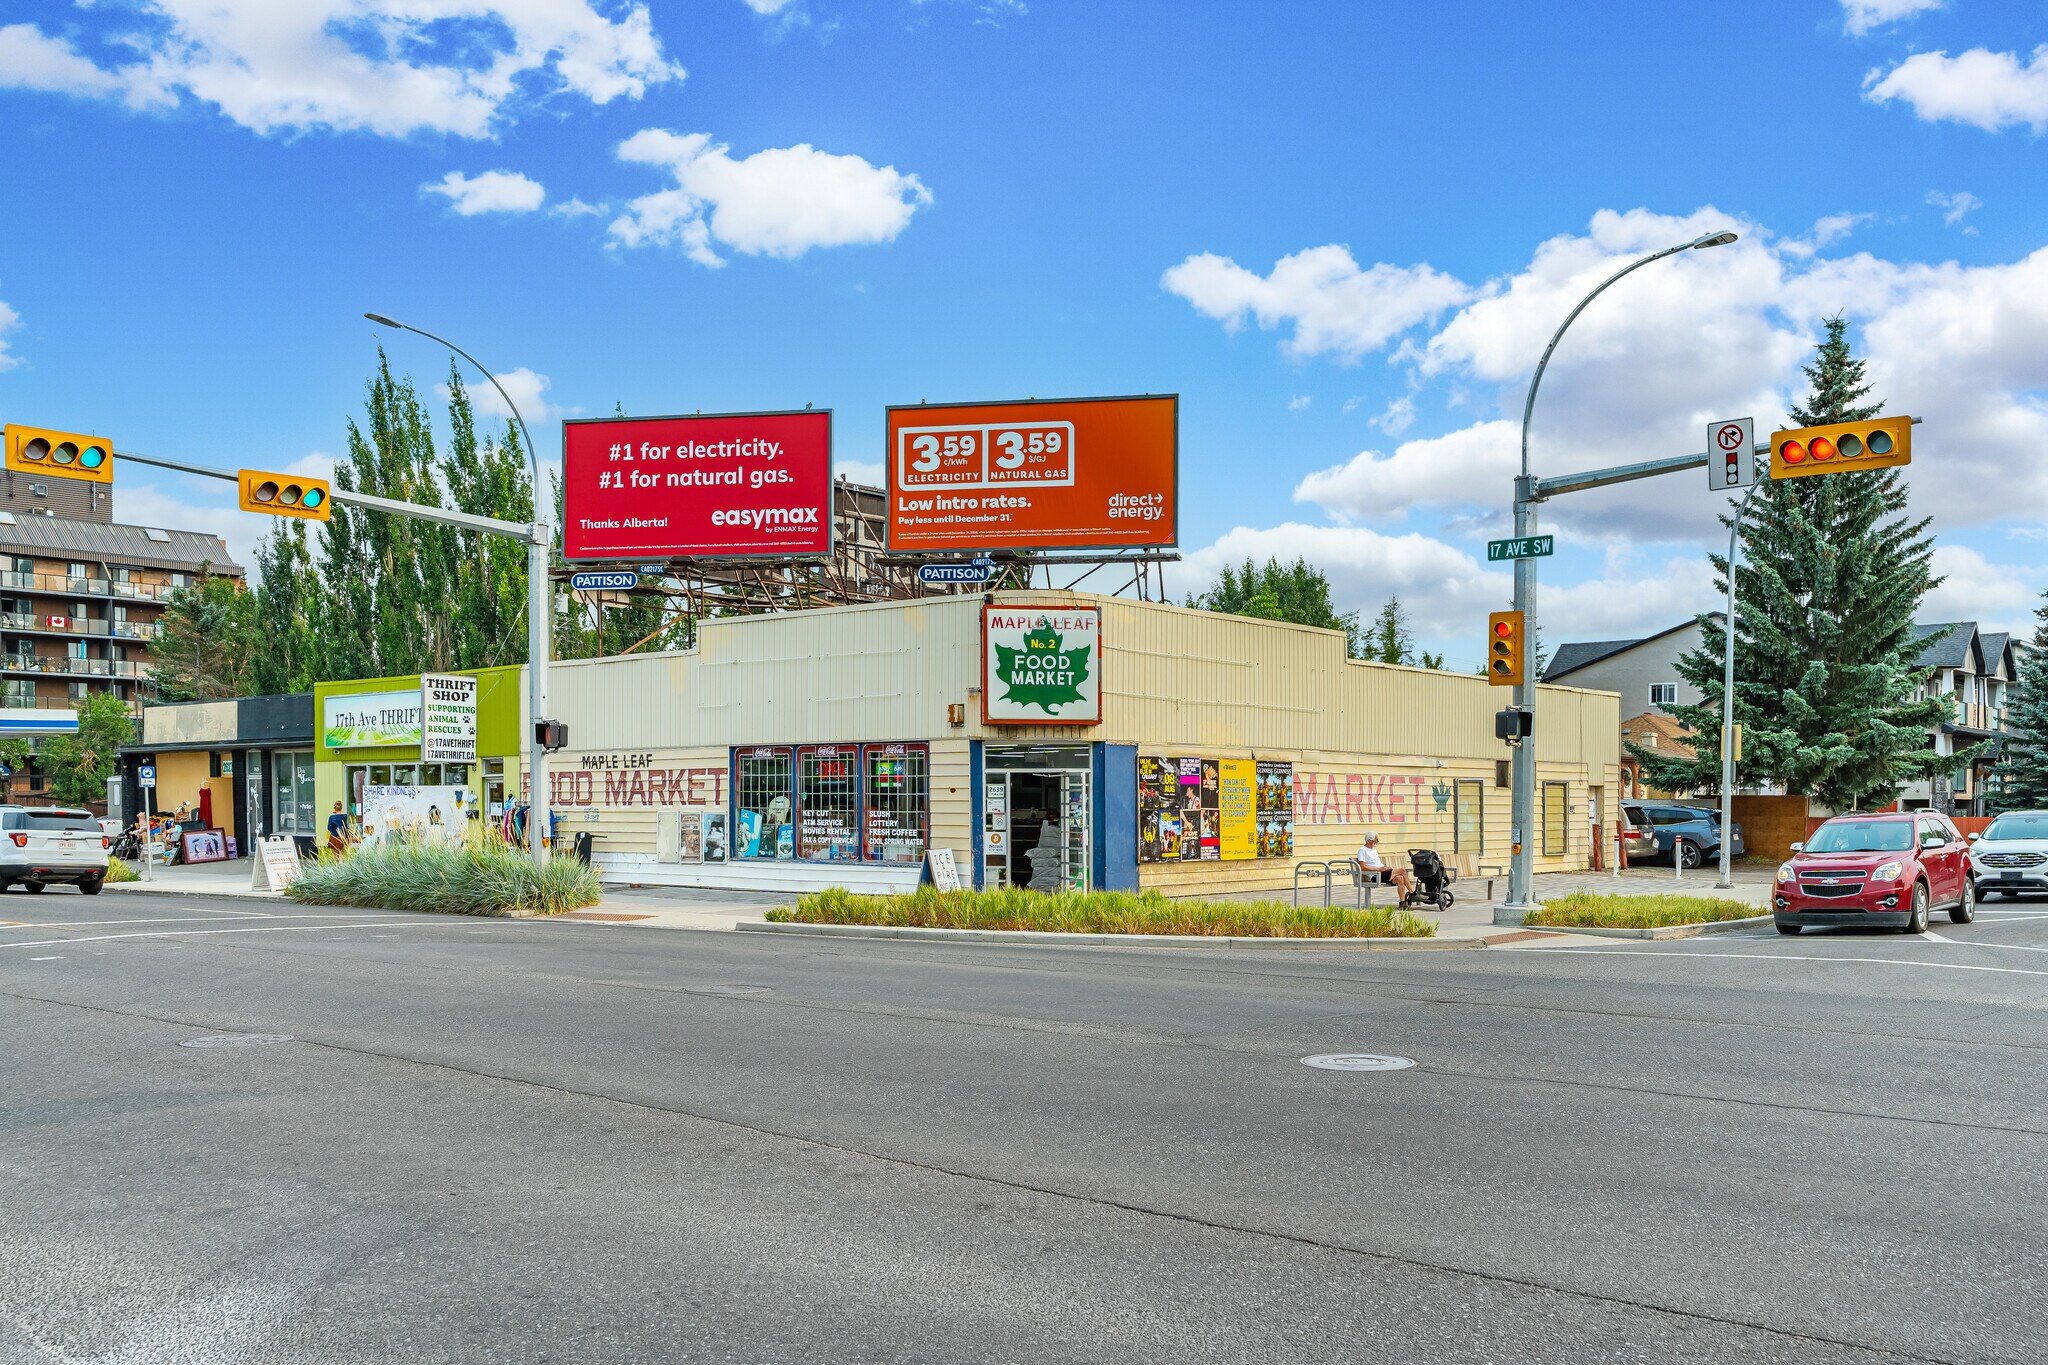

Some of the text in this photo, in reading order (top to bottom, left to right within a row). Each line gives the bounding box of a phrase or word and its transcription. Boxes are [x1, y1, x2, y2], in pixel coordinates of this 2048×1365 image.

[609, 438, 784, 461] #1 for electricity.
[1028, 454, 1047, 463] $/GJ
[599, 466, 794, 489] #1 for natural gas.
[908, 472, 980, 482] ELECTRICITY
[990, 469, 1067, 480] NATURAL GAS
[898, 494, 1032, 512] Low intro rates.
[1108, 492, 1154, 507] direct
[580, 516, 668, 530] Thanks Alberta!
[712, 507, 818, 530] easymax
[898, 516, 913, 526] Pay
[916, 516, 932, 524] less
[934, 515, 954, 524] until
[955, 514, 998, 523] December
[765, 526, 774, 534] by
[1490, 538, 1550, 558] 17 AVE SW
[924, 568, 985, 580] PATTISON
[576, 576, 633, 586] PATTISON
[990, 616, 1094, 630] MAPLE LEAF
[1030, 639, 1056, 649] No. 2
[1014, 655, 1070, 670] FOOD
[1011, 670, 1075, 686] MARKET
[426, 678, 476, 691] THRIFT
[432, 690, 470, 702] SHOP
[428, 704, 476, 714] SUPPORTING
[336, 712, 355, 728] 17th
[358, 711, 377, 726] Ave
[428, 715, 458, 724] ANIMAL
[428, 725, 462, 734] RESCUES
[427, 738, 475, 748] @17AVETHRIFT
[427, 750, 475, 760] 17AVETHRIFT.CA
[582, 754, 653, 770] MAPLE LEAF
[1164, 773, 1175, 785] 08
[364, 786, 416, 797] SHARE KINDNESS
[605, 768, 728, 806] MARKET
[1164, 785, 1175, 793] AUG
[1293, 773, 1425, 824] MARKET
[934, 853, 950, 865] ICE
[937, 870, 955, 880] FIRE
